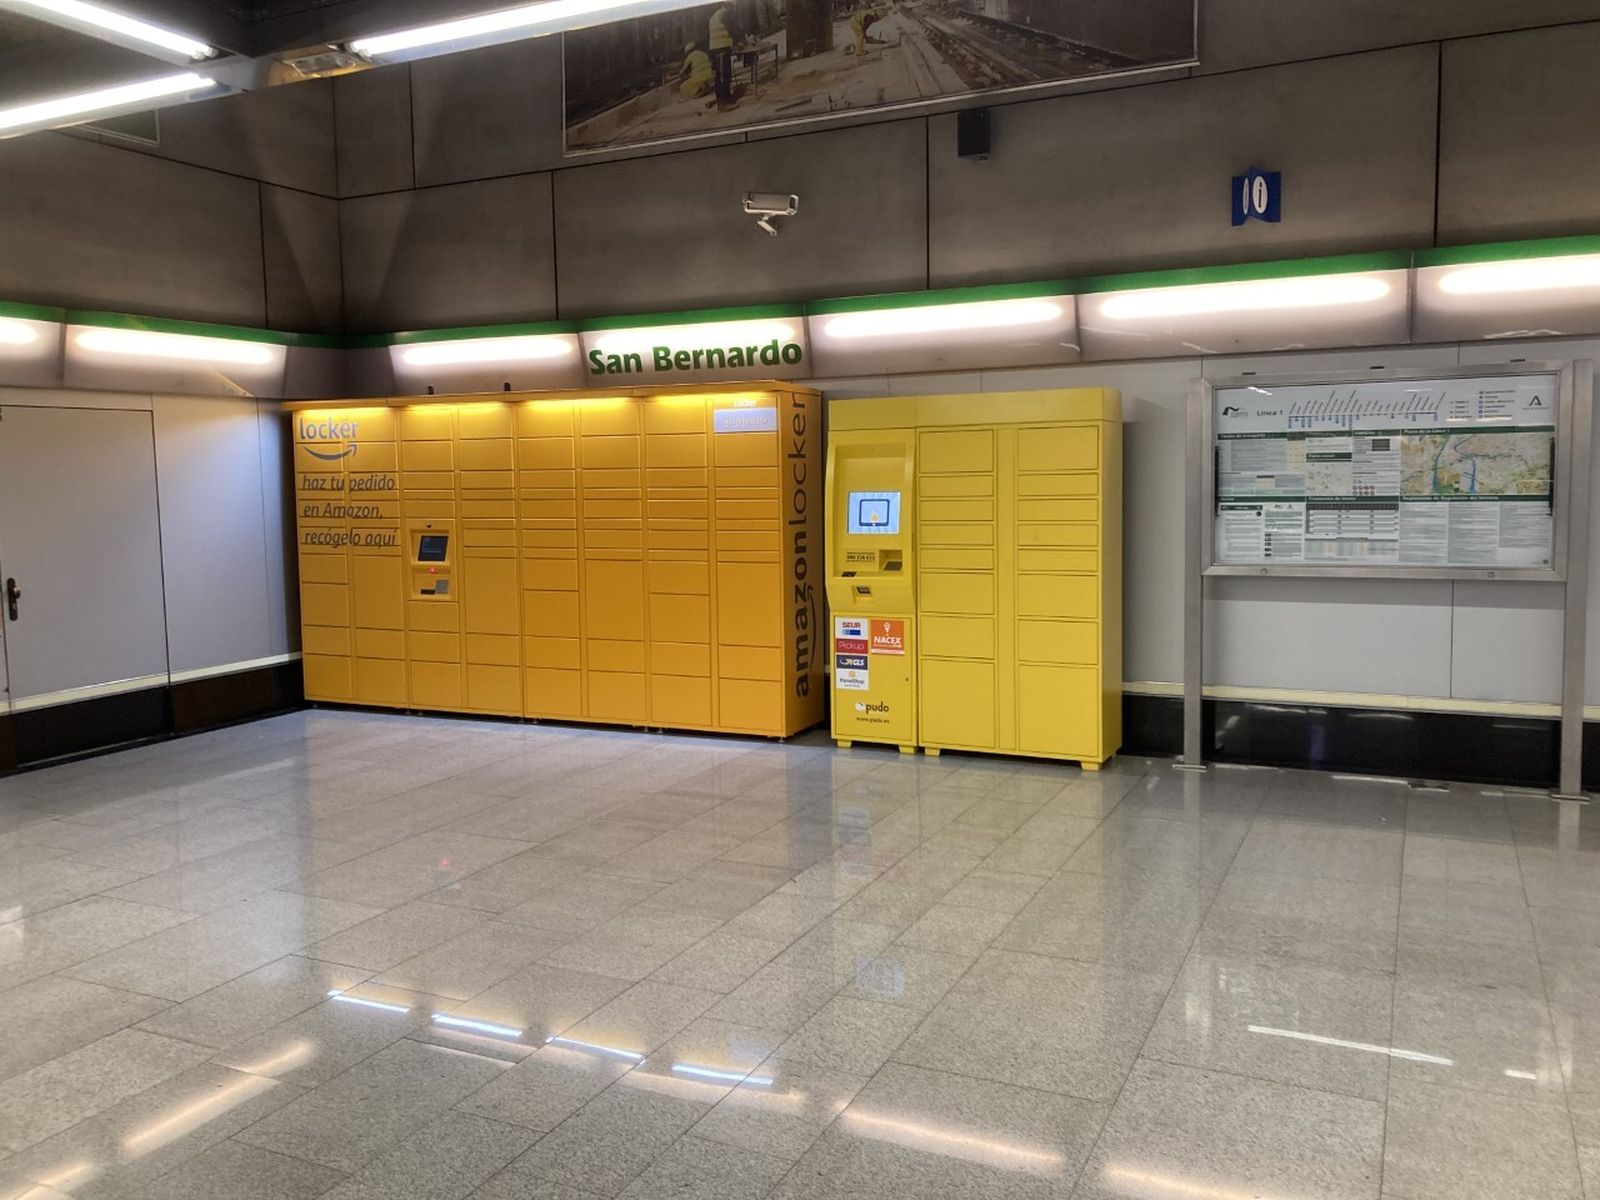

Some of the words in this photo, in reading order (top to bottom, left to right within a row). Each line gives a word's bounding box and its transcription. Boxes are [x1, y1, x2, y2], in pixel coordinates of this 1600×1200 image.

[589, 349, 643, 375] San
[653, 339, 802, 372] Bernardo
[300, 417, 359, 440] locker
[303, 474, 327, 490] haz
[330, 475, 345, 490] tu
[348, 474, 395, 495] pedido
[303, 505, 320, 518] en
[322, 502, 383, 519] Amazon,
[304, 527, 361, 548] recógelo
[365, 528, 398, 549] aquí
[838, 640, 865, 650] Pickup
[873, 636, 902, 645] NACEX
[865, 701, 890, 715] pudo
